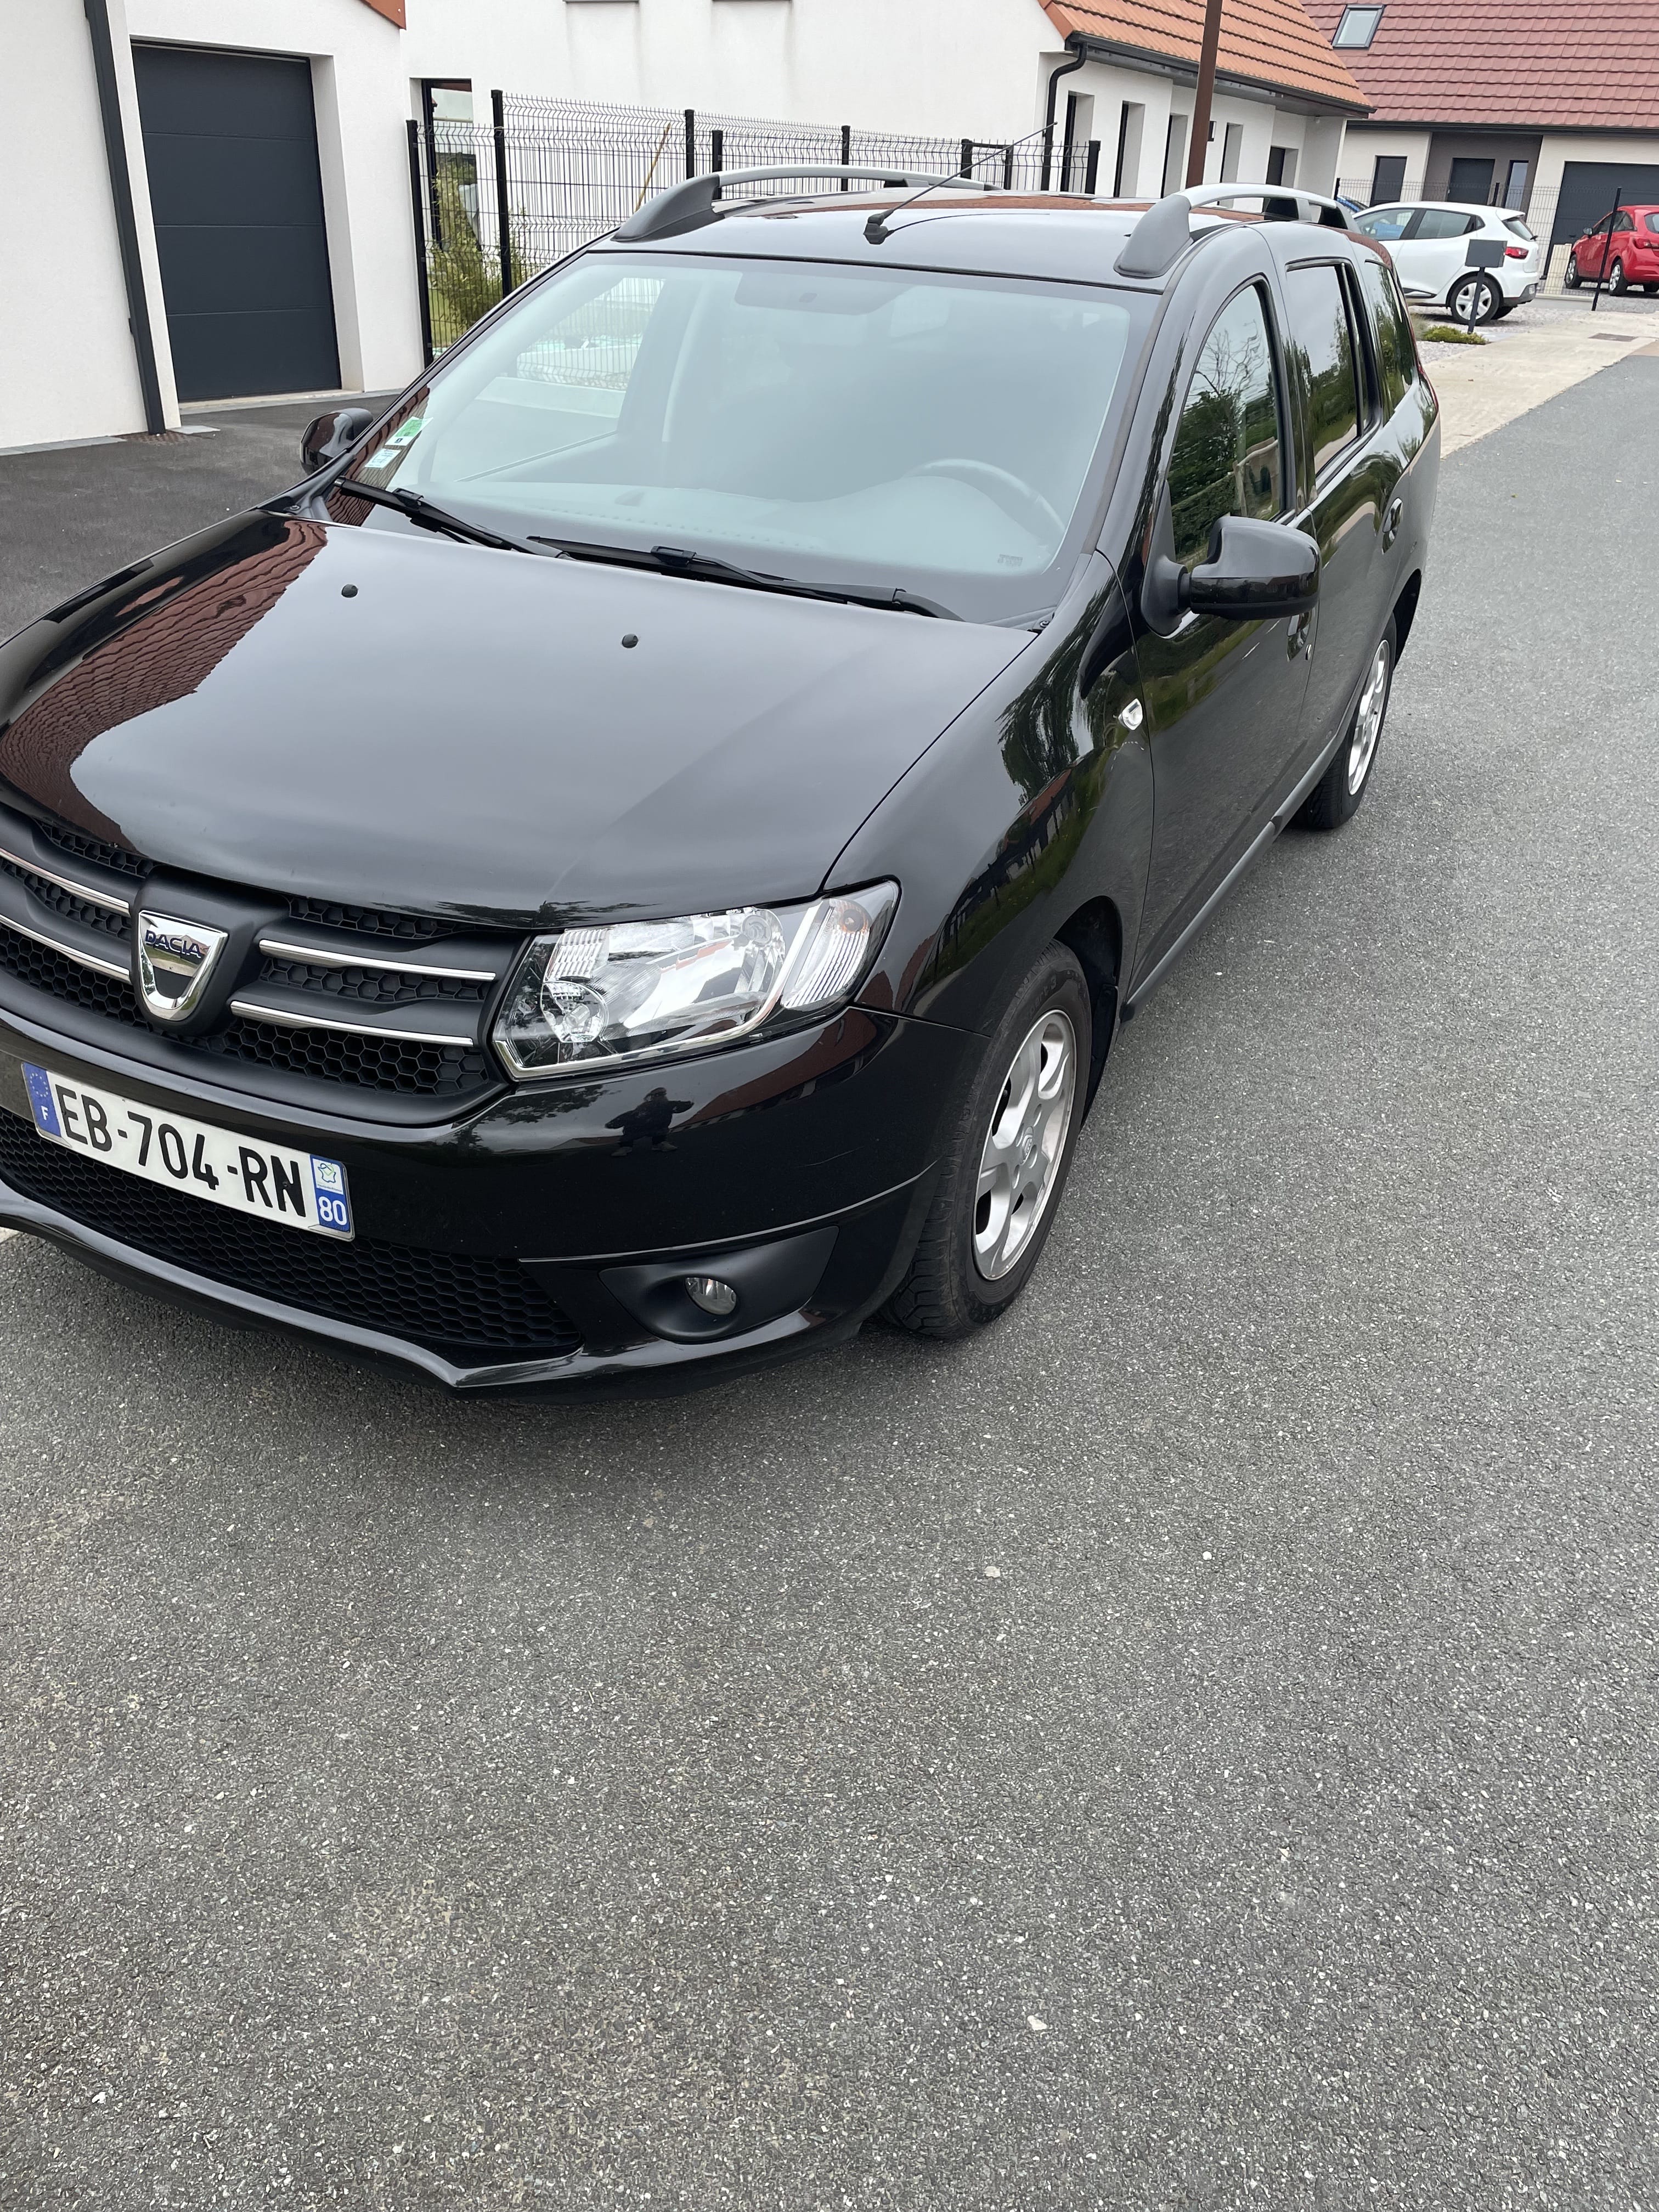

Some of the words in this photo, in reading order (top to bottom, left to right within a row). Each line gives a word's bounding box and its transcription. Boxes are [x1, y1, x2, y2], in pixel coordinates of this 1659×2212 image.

[145, 929, 201, 958] DACIA
[41, 1105, 49, 1120] F
[55, 1084, 306, 1217] EB-704-RN
[318, 1196, 347, 1226] 80
